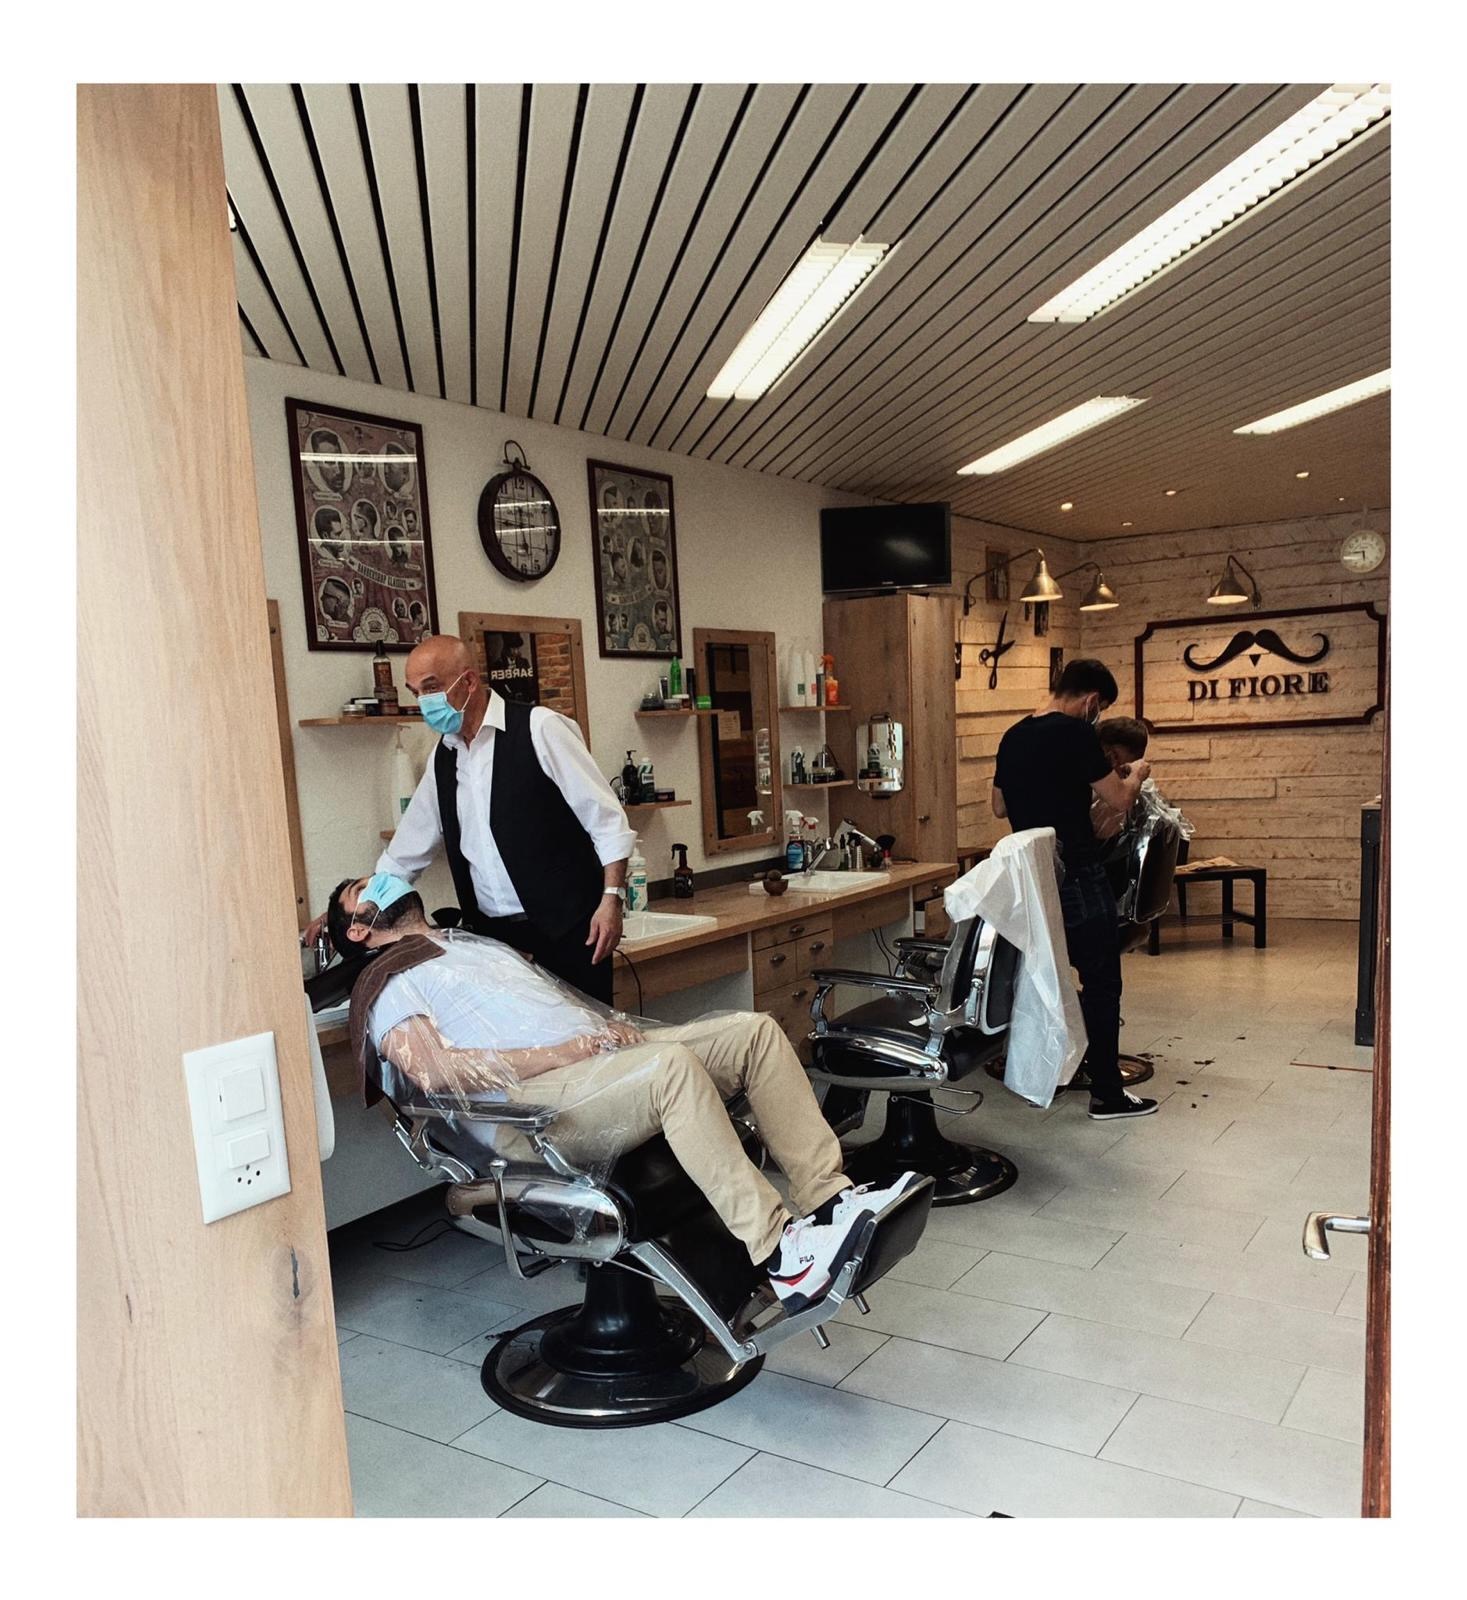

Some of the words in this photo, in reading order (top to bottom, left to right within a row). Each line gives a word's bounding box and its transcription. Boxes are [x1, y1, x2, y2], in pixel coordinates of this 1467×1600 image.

[514, 478, 525, 490] 12
[358, 563, 386, 585] BARBERSHOP
[1187, 679, 1219, 701] DI
[1229, 672, 1329, 698] FIORE
[799, 1254, 815, 1264] FILA
